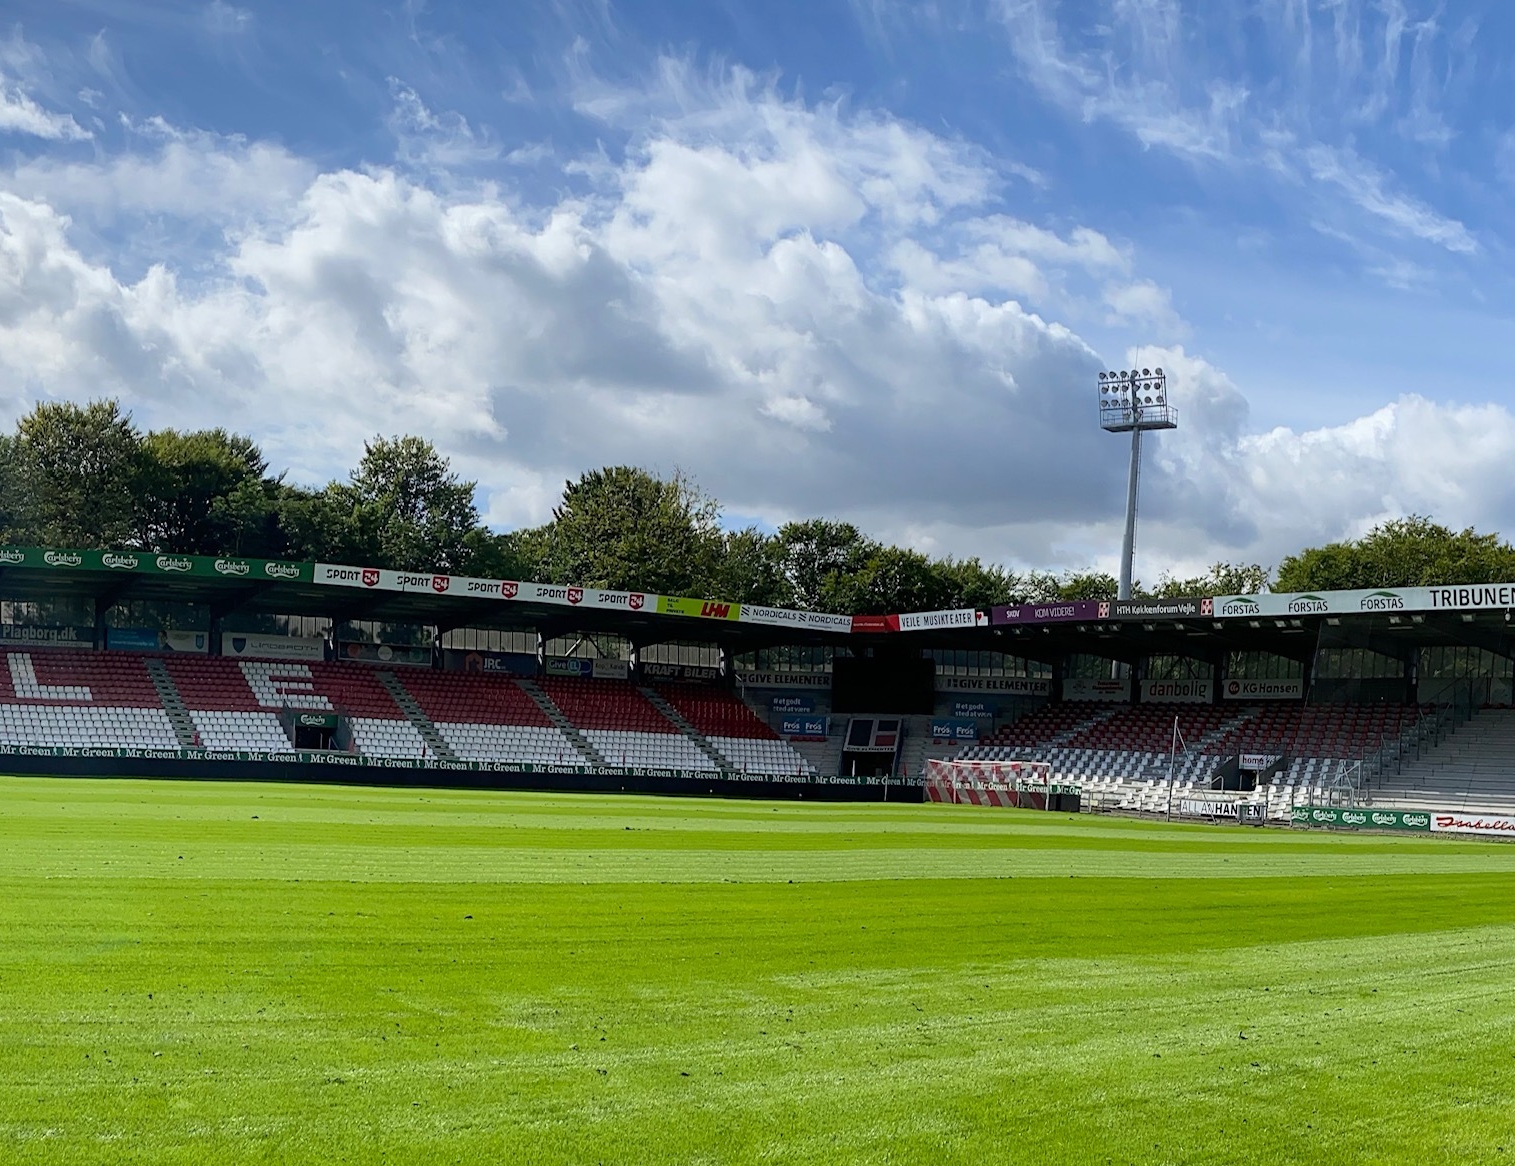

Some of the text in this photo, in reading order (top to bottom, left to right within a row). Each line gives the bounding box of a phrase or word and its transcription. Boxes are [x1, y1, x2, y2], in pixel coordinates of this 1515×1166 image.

[214, 559, 250, 576] Carlsberg
[326, 568, 361, 582] SPORT
[396, 575, 430, 587] SPORT
[467, 581, 500, 593] SPORT
[536, 587, 566, 600] SPORT
[598, 593, 627, 604] SPORT
[1034, 607, 1075, 619] KOM VIDERE!
[1116, 603, 1197, 616] HTH Køkkenforum Vejle
[1222, 603, 1260, 615] FORSTAS
[1288, 601, 1329, 614] FORSTAS
[1360, 598, 1404, 611] FORSTAS
[753, 608, 797, 621] NORDICALS
[808, 614, 851, 627] NORDICALS
[901, 612, 972, 628] VEJLE MUSIKTEATER
[1, 624, 78, 644] Plagborg.dk
[483, 657, 502, 670] JRC
[548, 659, 567, 670] Give
[643, 663, 717, 680] KRAFT BILER
[748, 672, 830, 686] GIVE ELEMENTER
[959, 679, 1047, 692] GIVE ELEMENTER
[1149, 680, 1208, 699] danbolig
[1242, 683, 1298, 694] KG Hansen
[126, 748, 142, 759] Mr
[144, 749, 176, 760] Green
[1312, 810, 1337, 823] Carlsberg
[1402, 813, 1428, 828] Carlsberg
